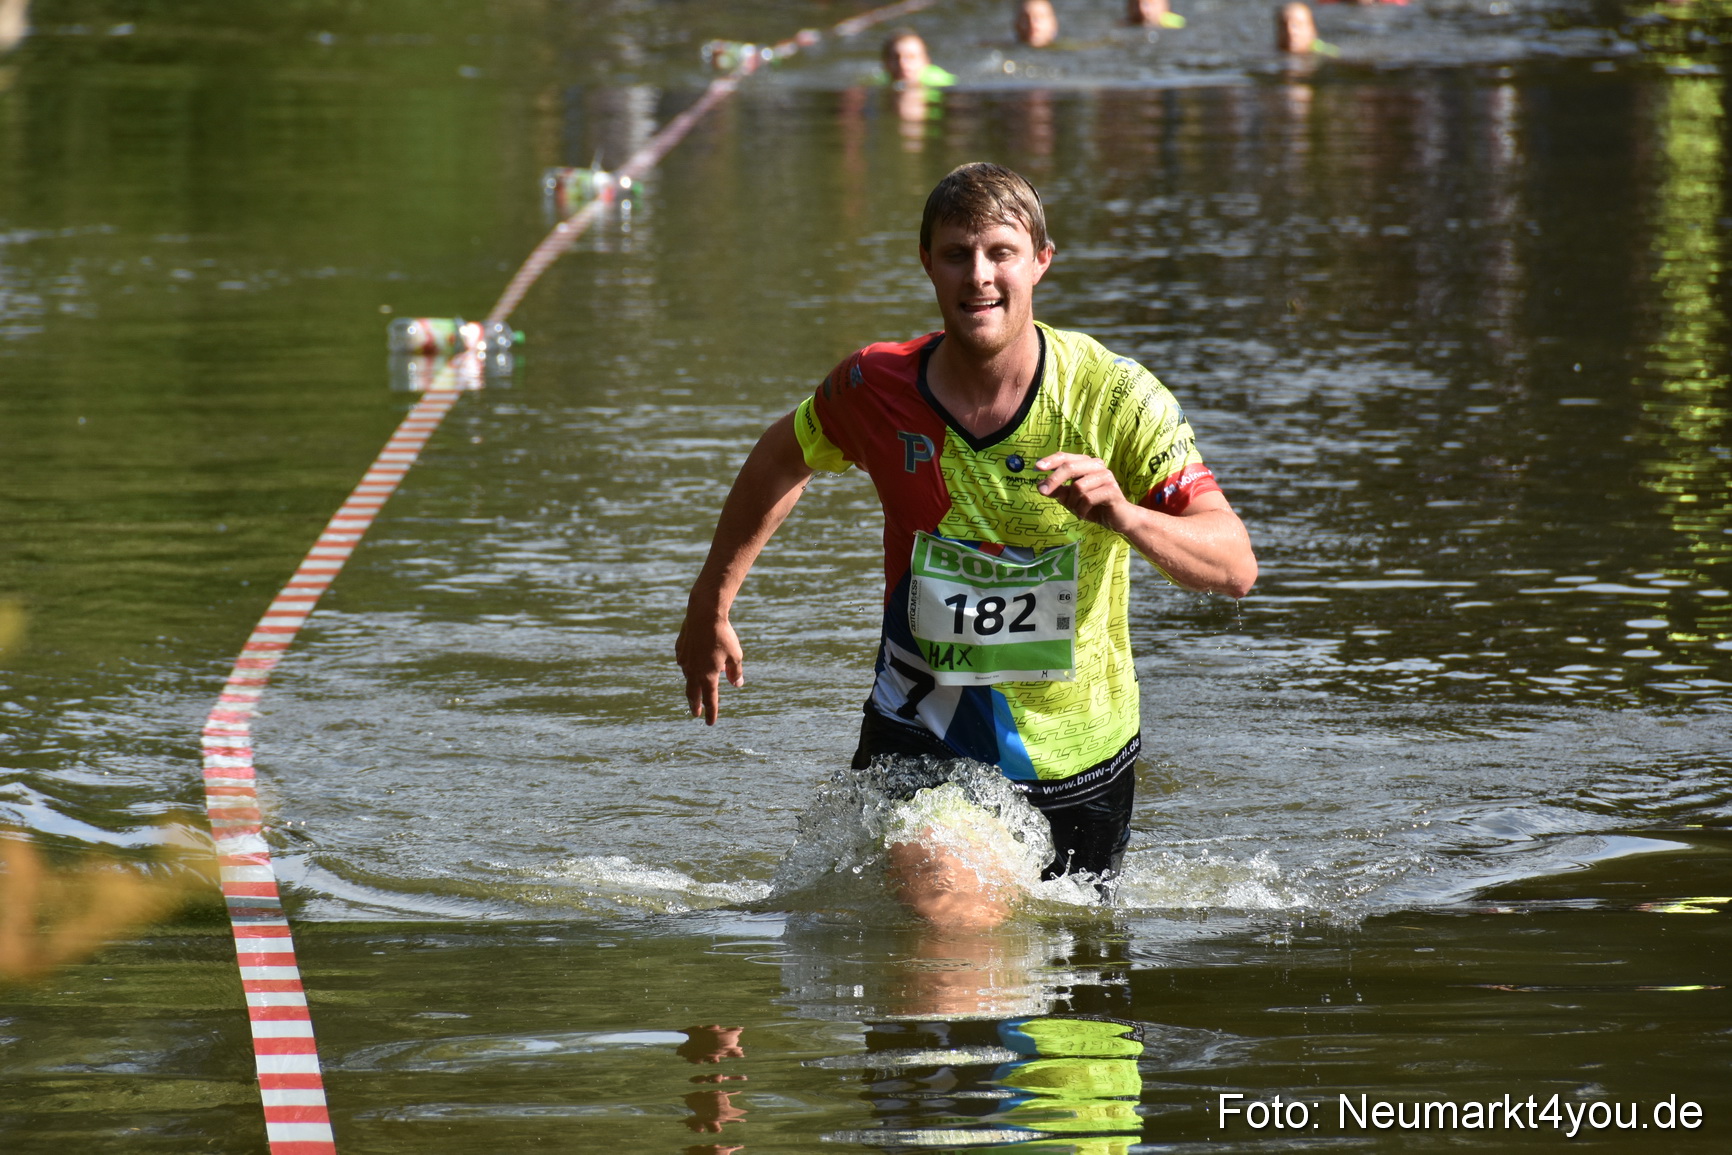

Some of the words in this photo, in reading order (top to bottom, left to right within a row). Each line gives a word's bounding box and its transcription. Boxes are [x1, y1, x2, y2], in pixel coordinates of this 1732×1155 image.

[944, 592, 1037, 636] 182
[1059, 593, 1071, 601] E6
[1043, 738, 1140, 795] www.bmw-partl.de
